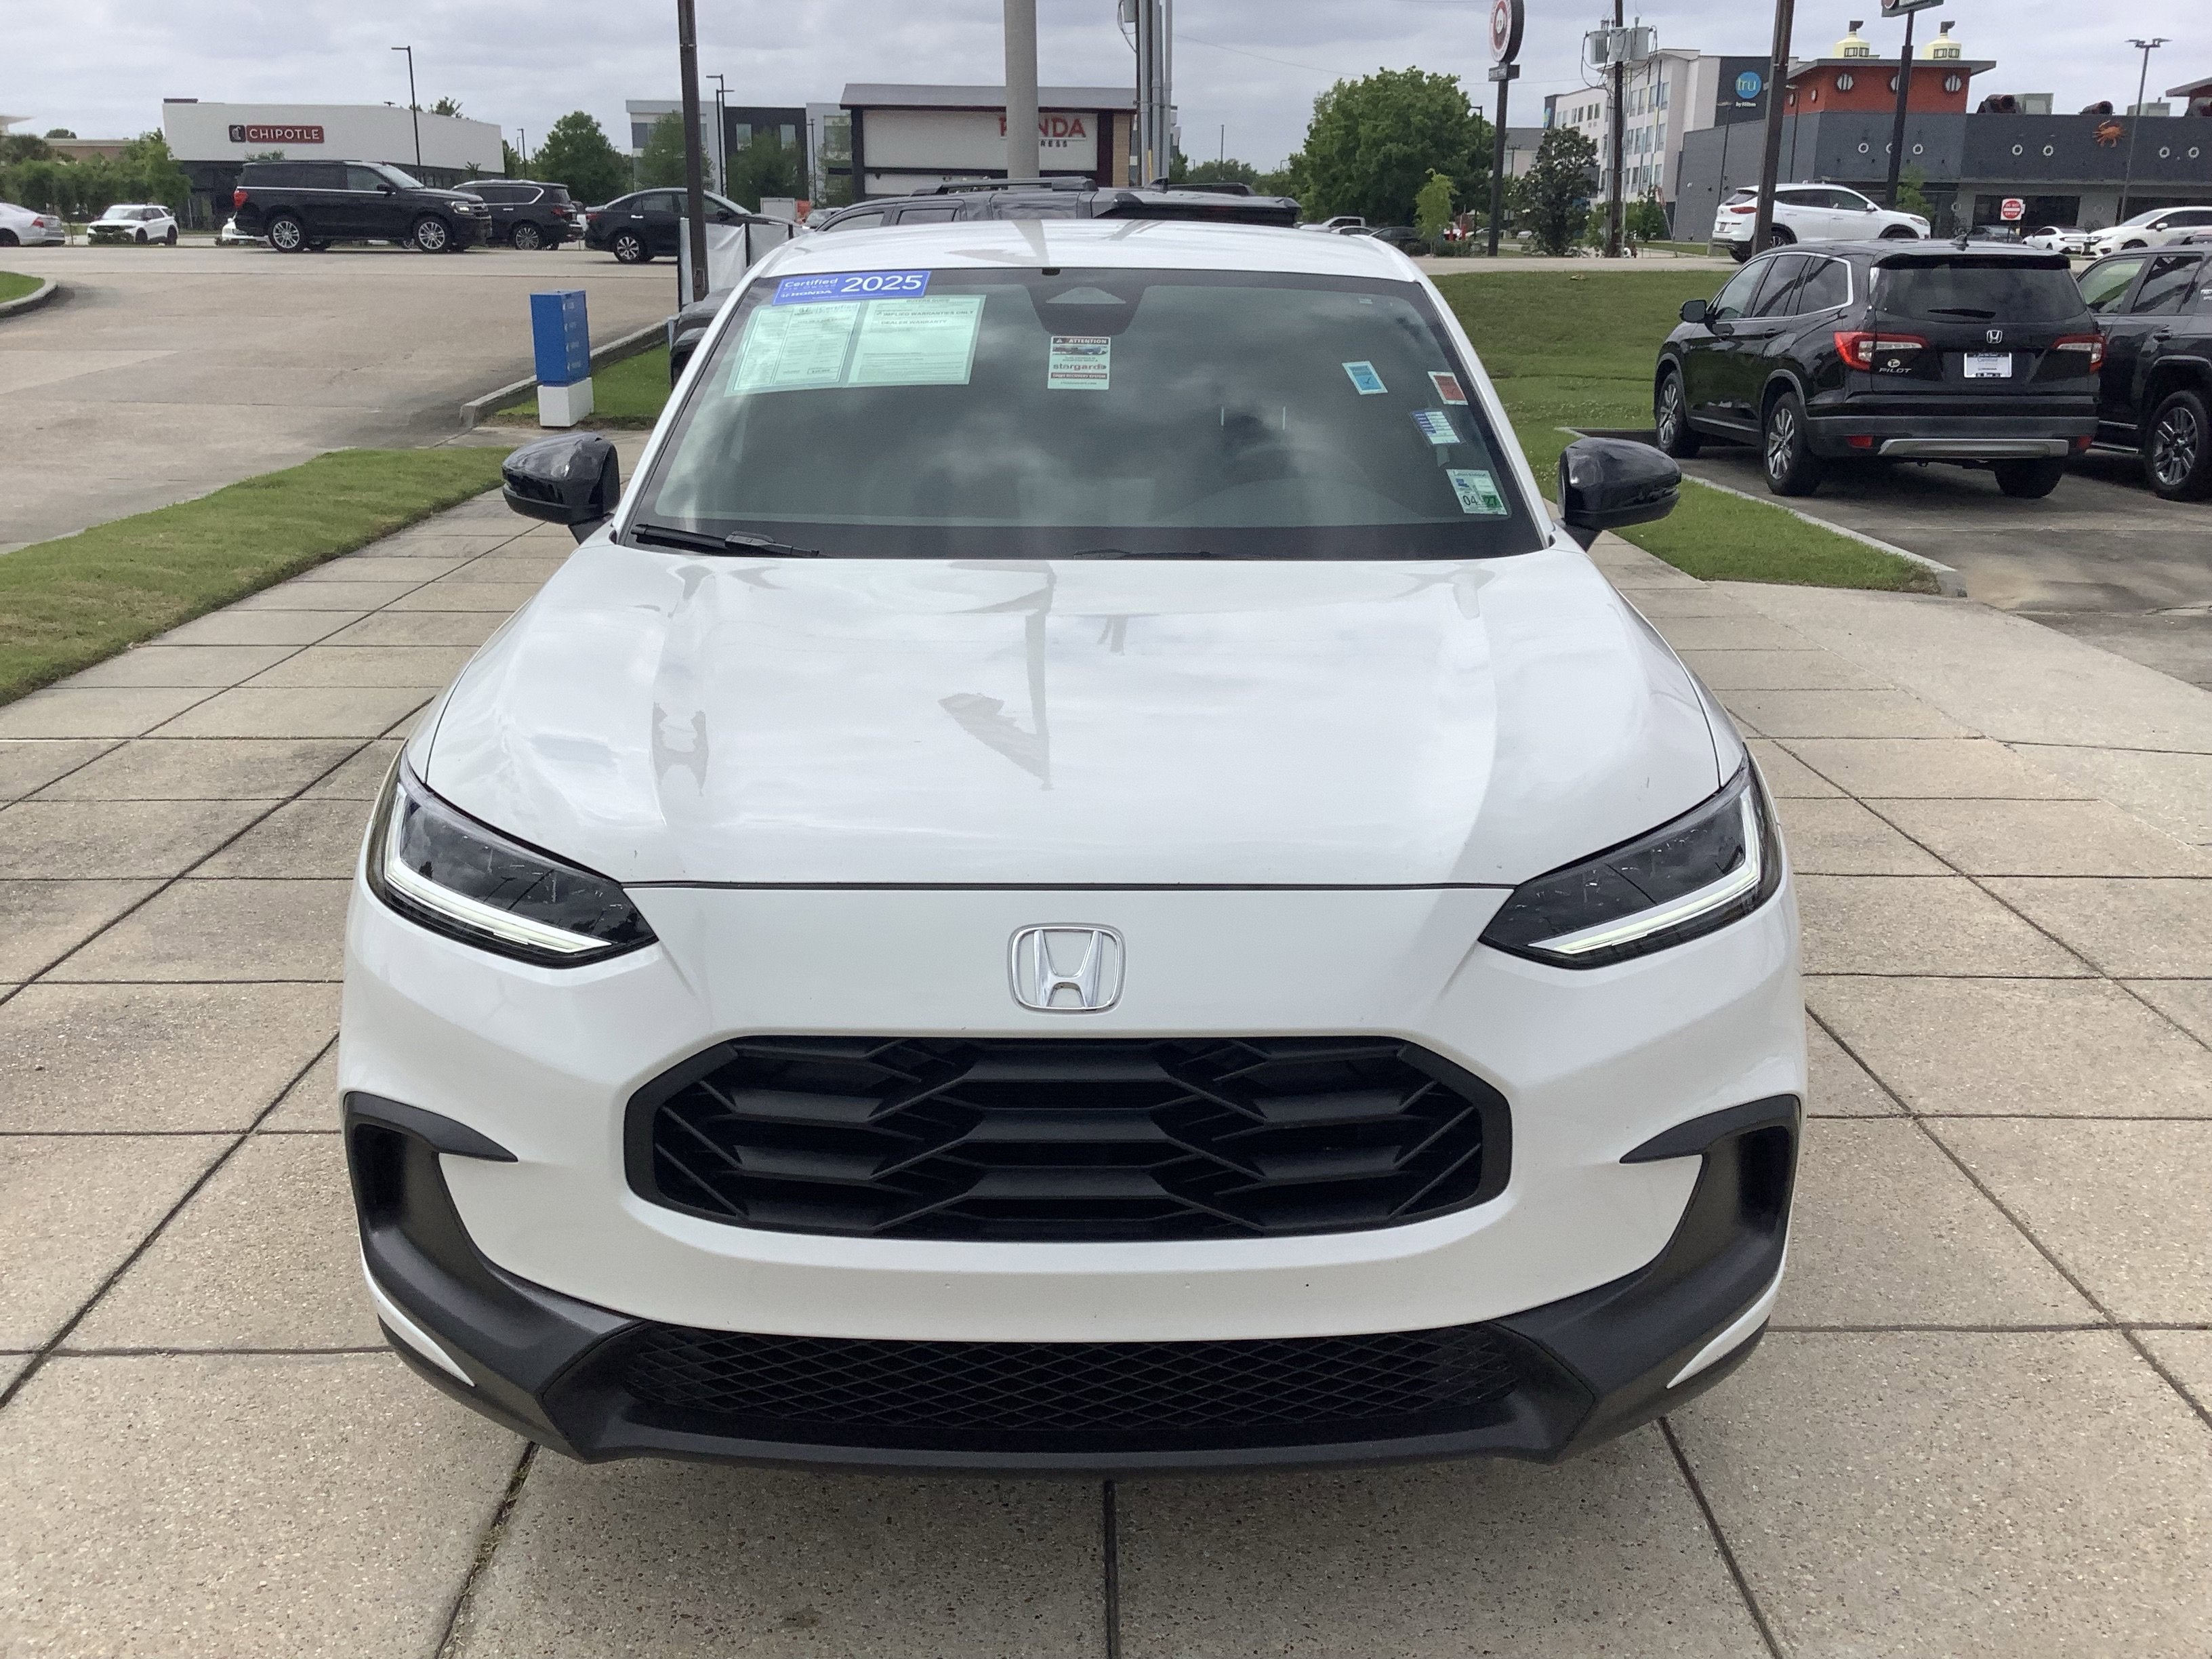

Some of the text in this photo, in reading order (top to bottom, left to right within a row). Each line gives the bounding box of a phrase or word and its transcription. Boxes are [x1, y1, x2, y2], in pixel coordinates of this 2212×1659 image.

[1736, 77, 1757, 91] tru
[998, 117, 1086, 138] PNDA
[249, 129, 321, 140] CHIPOTLE
[785, 278, 838, 288] Certified
[840, 274, 924, 293] 2025
[1462, 495, 1478, 506] 04
